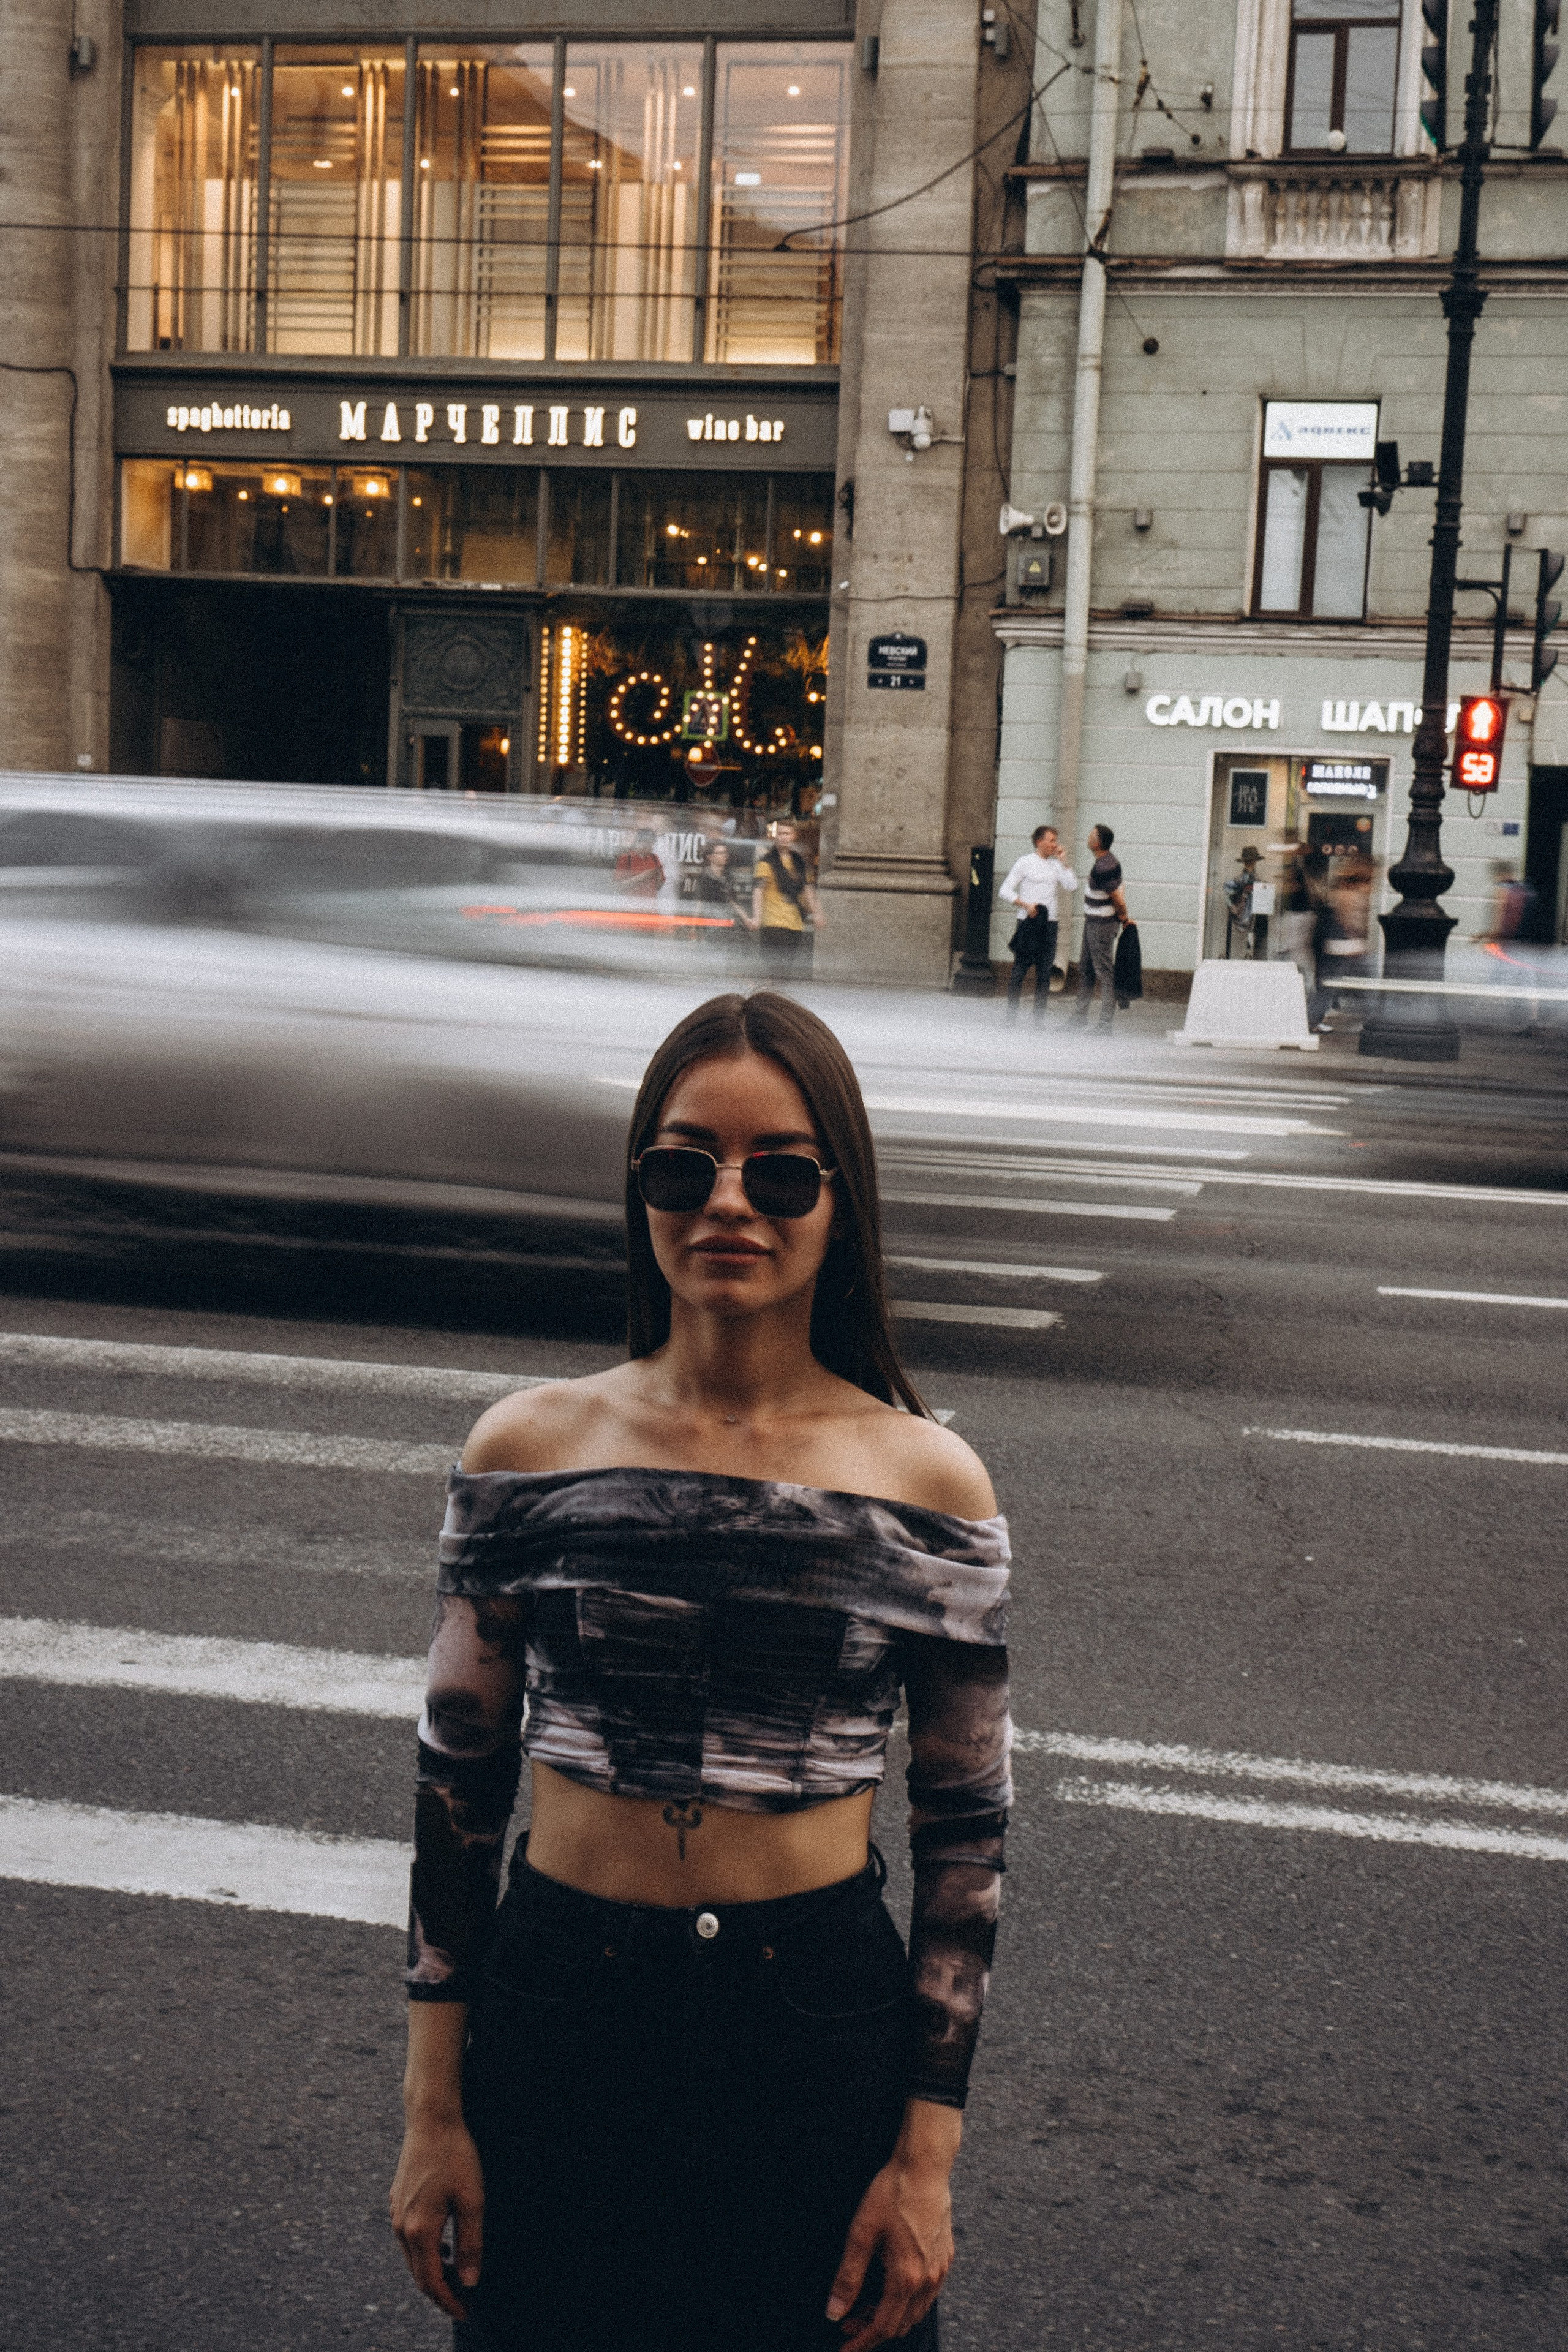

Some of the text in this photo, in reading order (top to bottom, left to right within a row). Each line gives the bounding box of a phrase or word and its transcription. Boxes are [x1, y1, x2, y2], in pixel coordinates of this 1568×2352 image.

[745, 414, 785, 442] bar
[890, 675, 901, 687] 21
[1145, 695, 1280, 729] САЛОН
